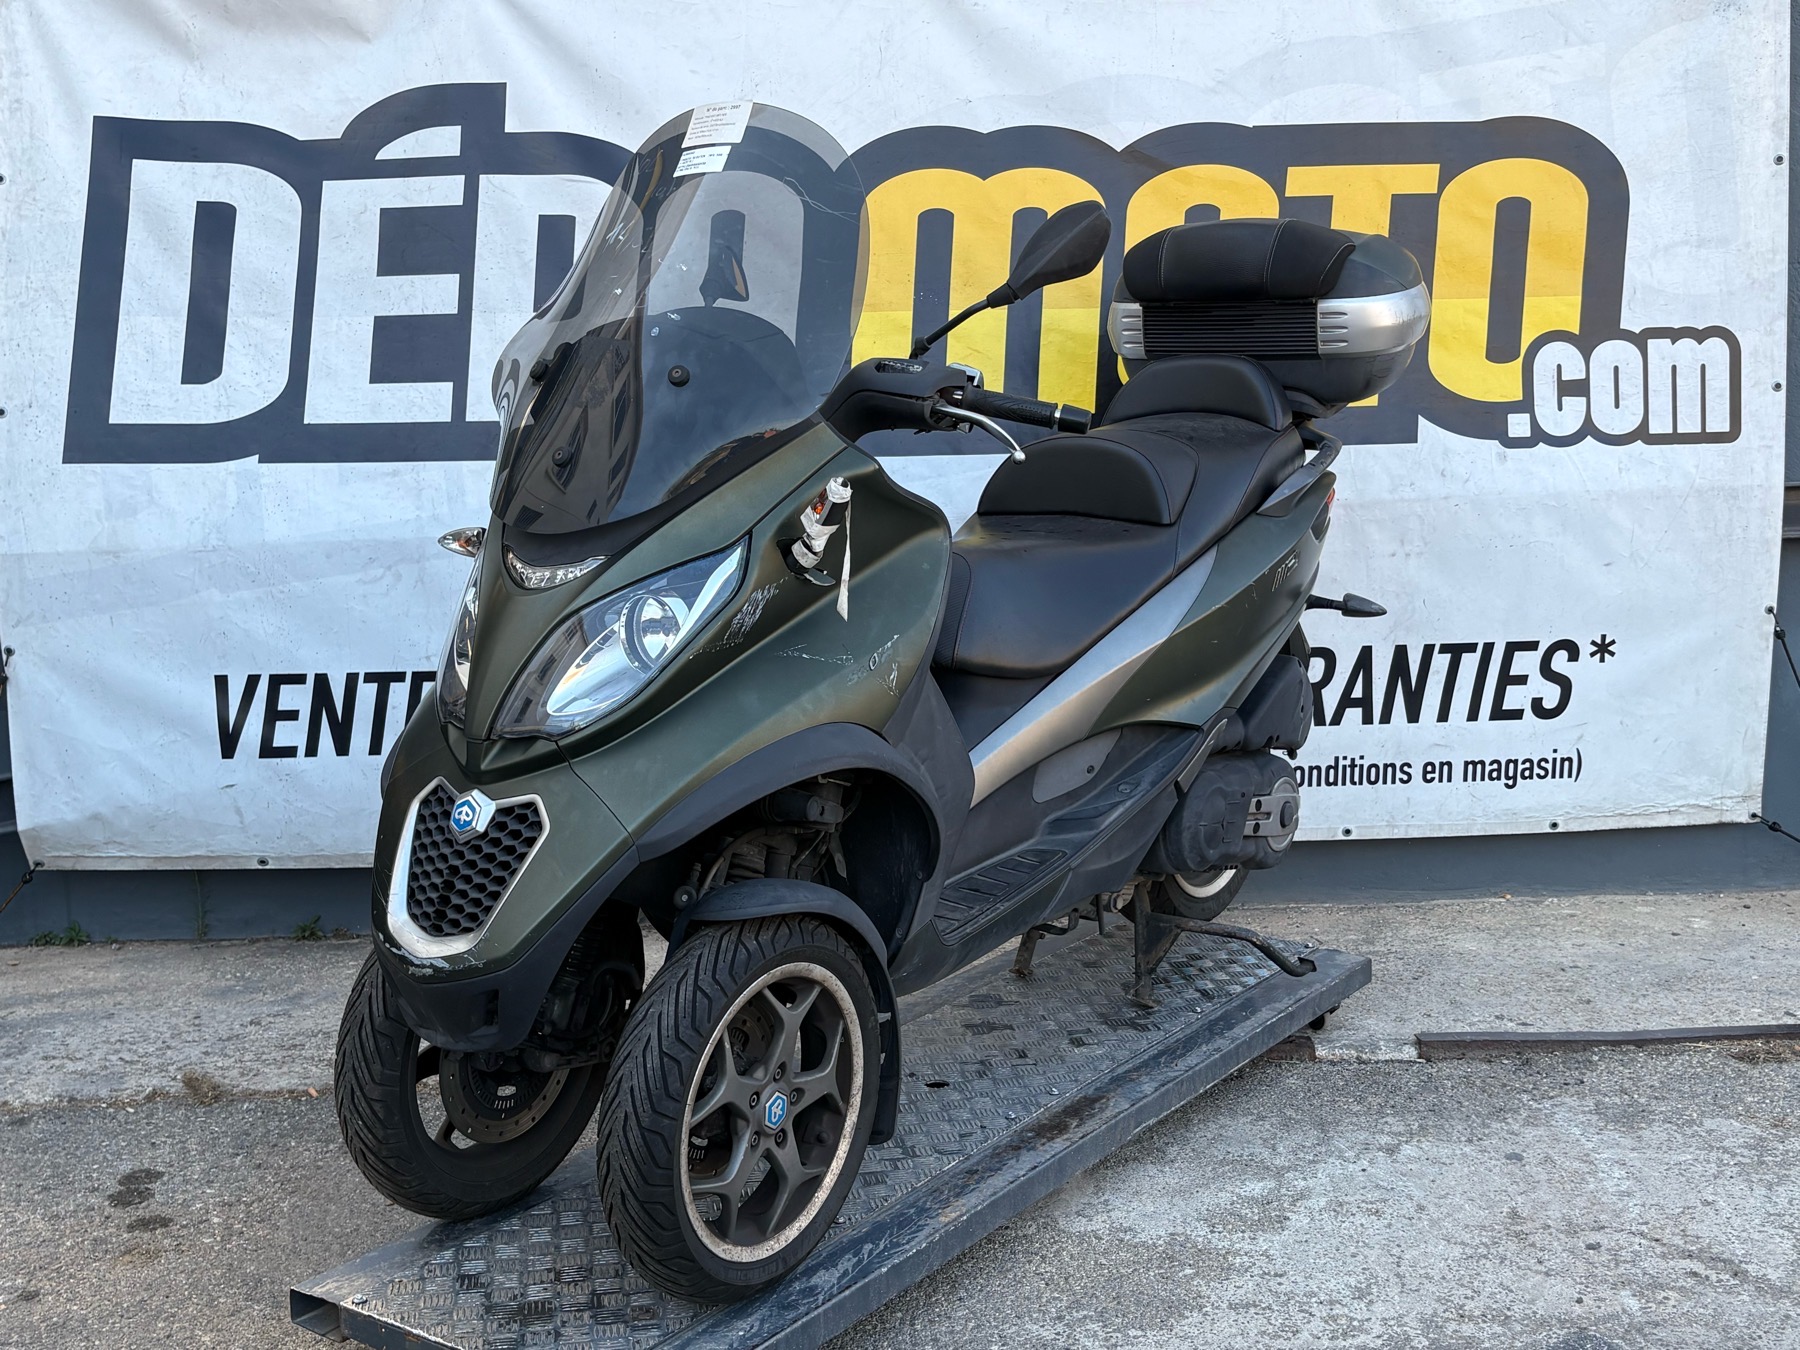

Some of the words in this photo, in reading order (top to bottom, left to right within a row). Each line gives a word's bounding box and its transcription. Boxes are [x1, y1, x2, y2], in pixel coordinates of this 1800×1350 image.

[1307, 634, 1617, 727] RANTIES
[1294, 754, 1412, 788] onditions
[1422, 759, 1453, 784] en
[1463, 747, 1583, 790] magasin)
